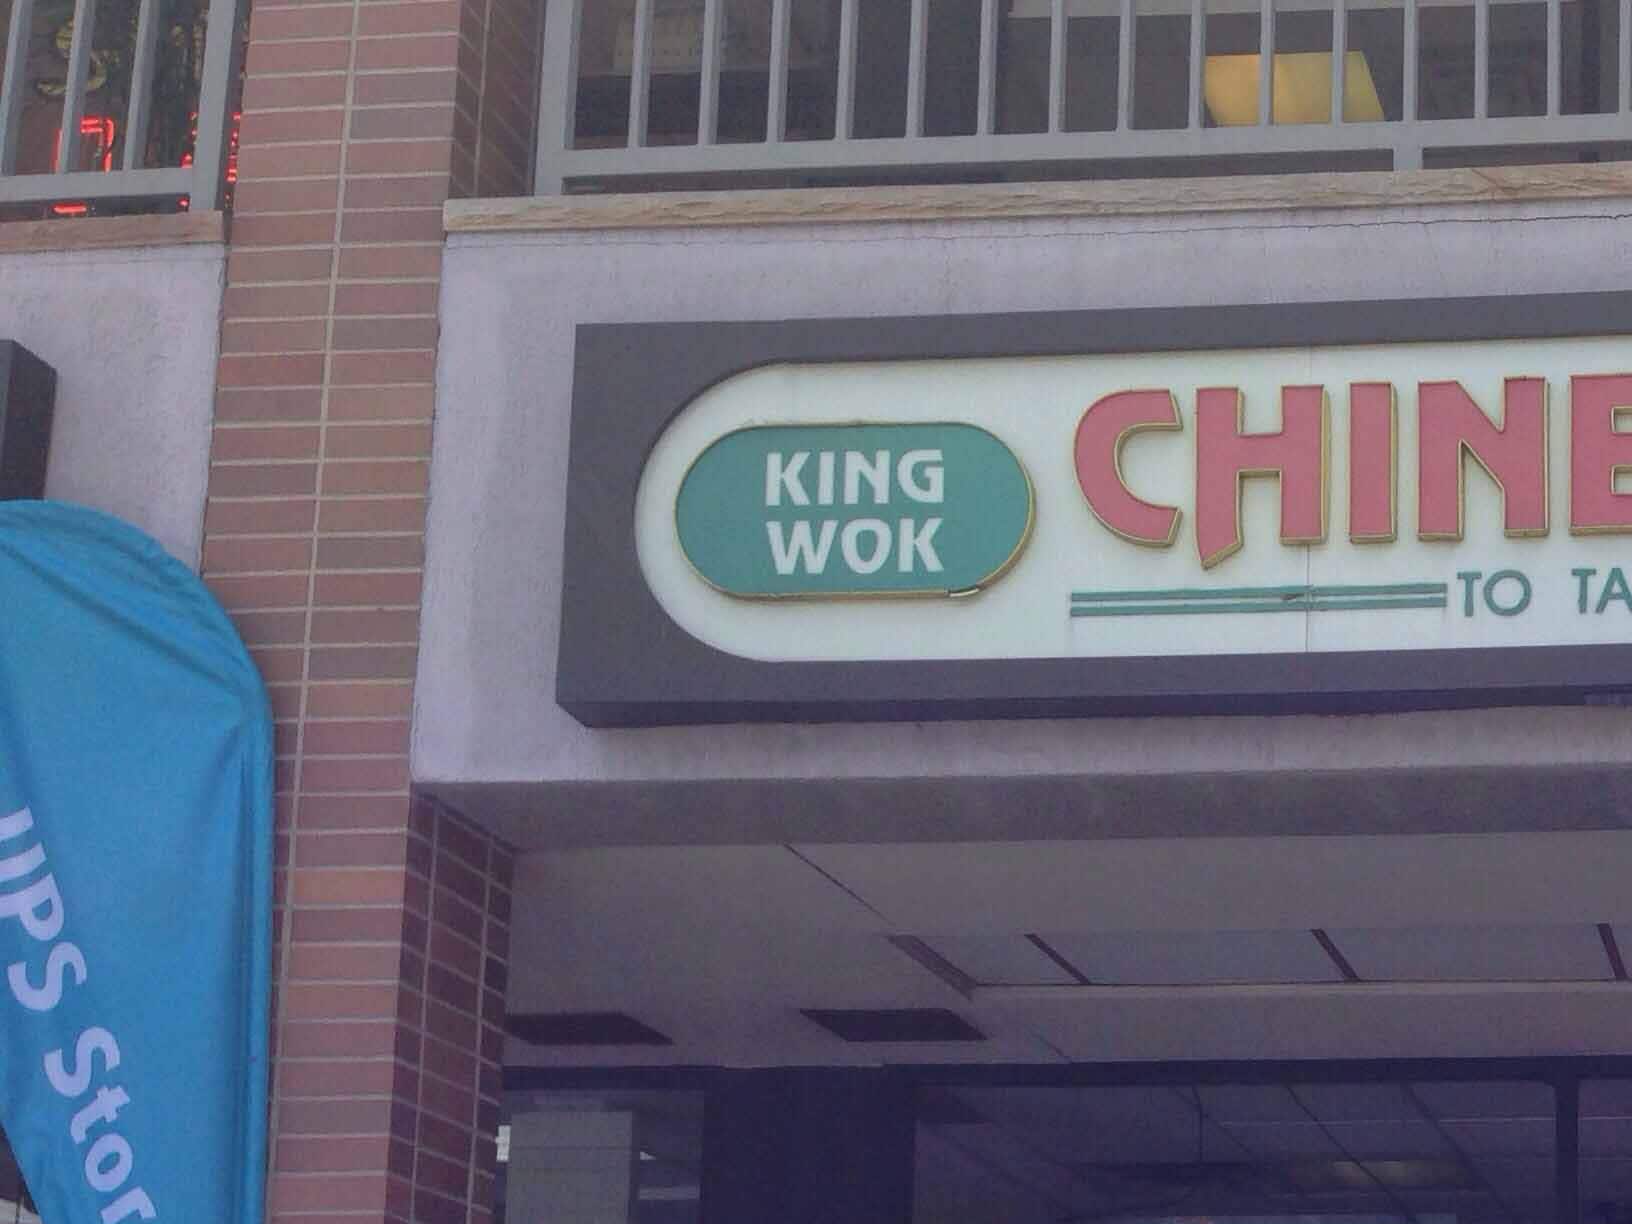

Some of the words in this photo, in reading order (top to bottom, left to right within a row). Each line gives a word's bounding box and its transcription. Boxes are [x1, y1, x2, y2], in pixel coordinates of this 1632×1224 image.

[764, 448, 945, 507] KING
[764, 517, 945, 576] WOK
[1456, 568, 1533, 617] TO
